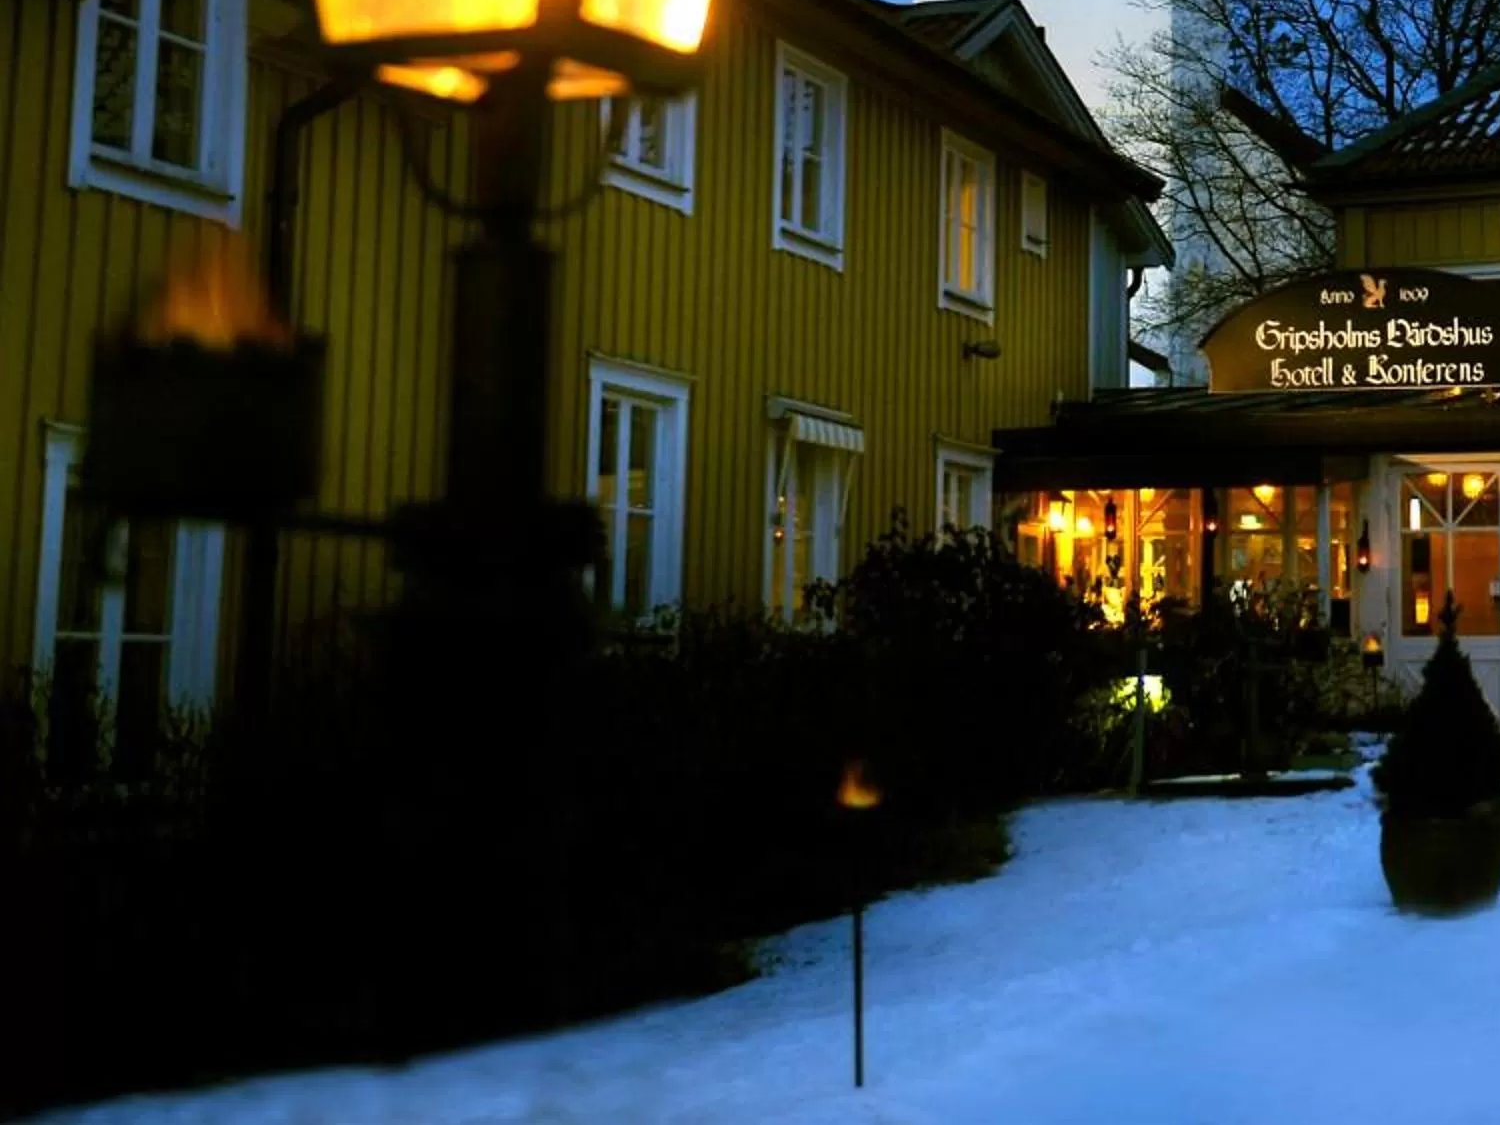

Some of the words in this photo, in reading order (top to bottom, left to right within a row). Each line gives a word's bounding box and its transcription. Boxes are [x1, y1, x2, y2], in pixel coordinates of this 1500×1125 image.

[1255, 319, 1381, 354] Gripsholms
[1387, 316, 1494, 348] Värdshus
[1270, 356, 1334, 388] Hotell
[1341, 364, 1357, 386] &
[1365, 354, 1485, 386] Konferens
